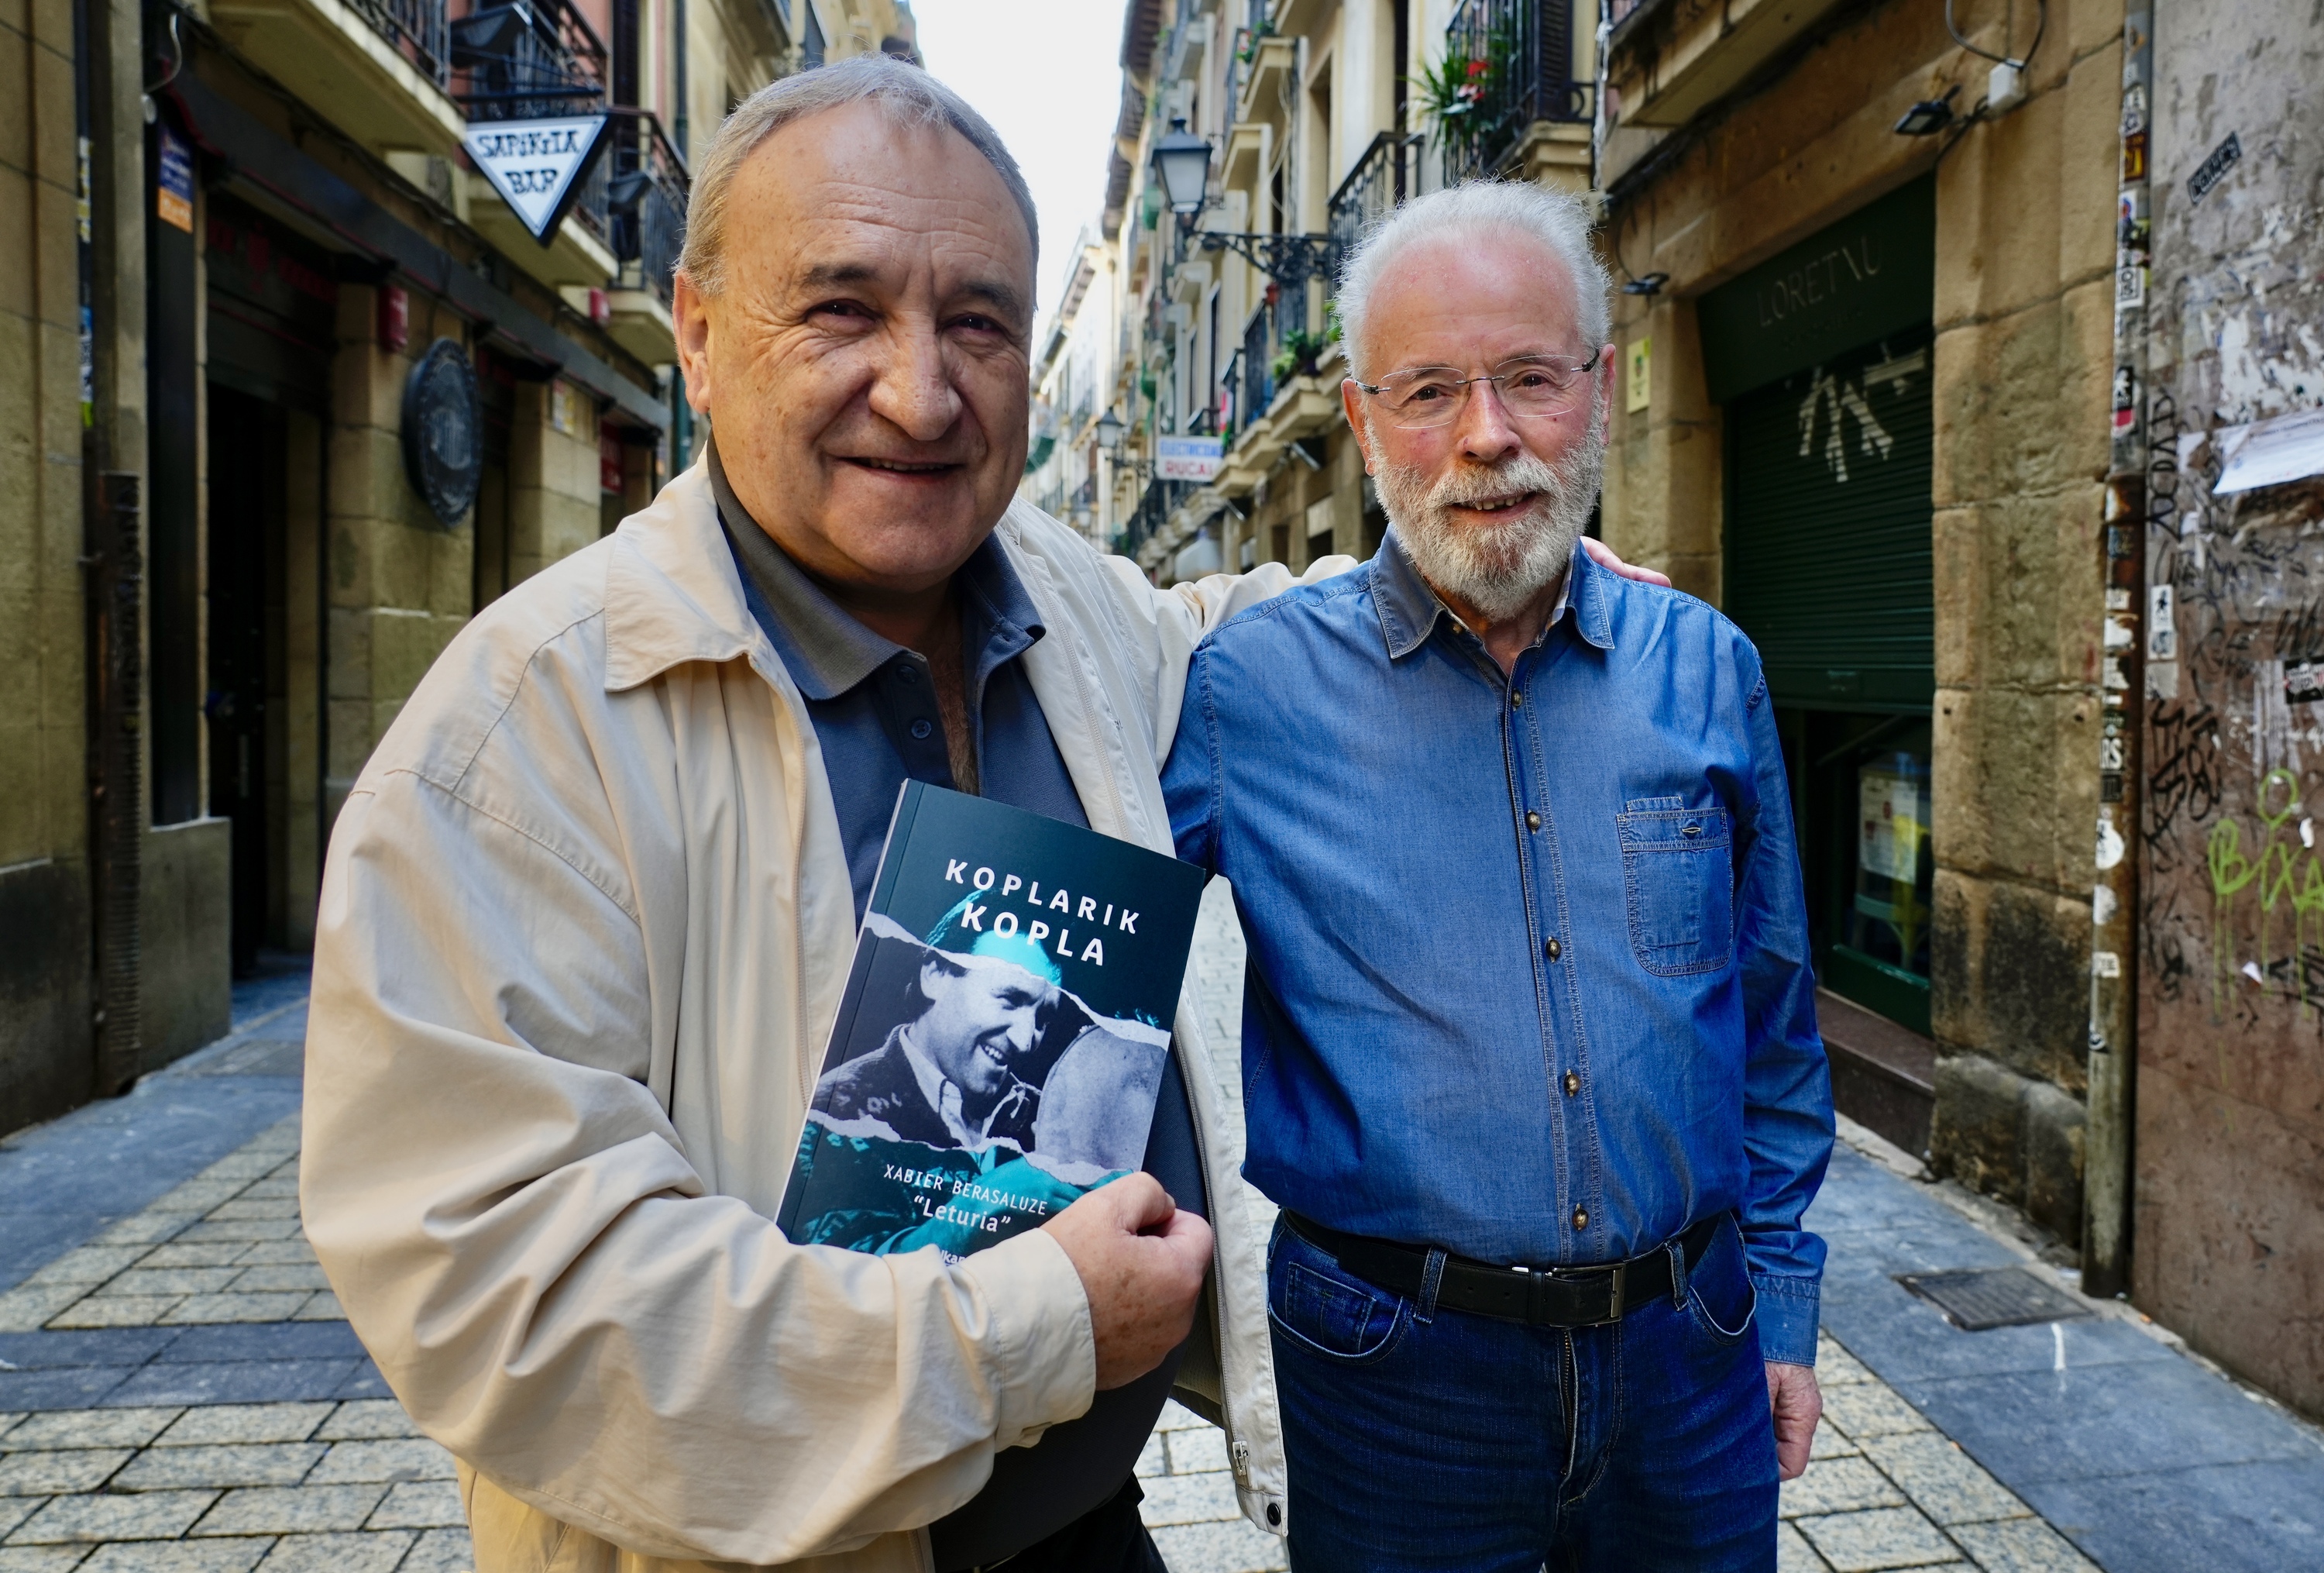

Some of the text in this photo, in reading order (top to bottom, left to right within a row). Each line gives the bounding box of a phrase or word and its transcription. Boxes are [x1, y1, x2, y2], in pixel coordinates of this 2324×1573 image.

[944, 859, 1140, 934] KOPLARIK
[961, 901, 1104, 966] KOPLA
[883, 1164, 1048, 1216] XABIER BERASALUZE
